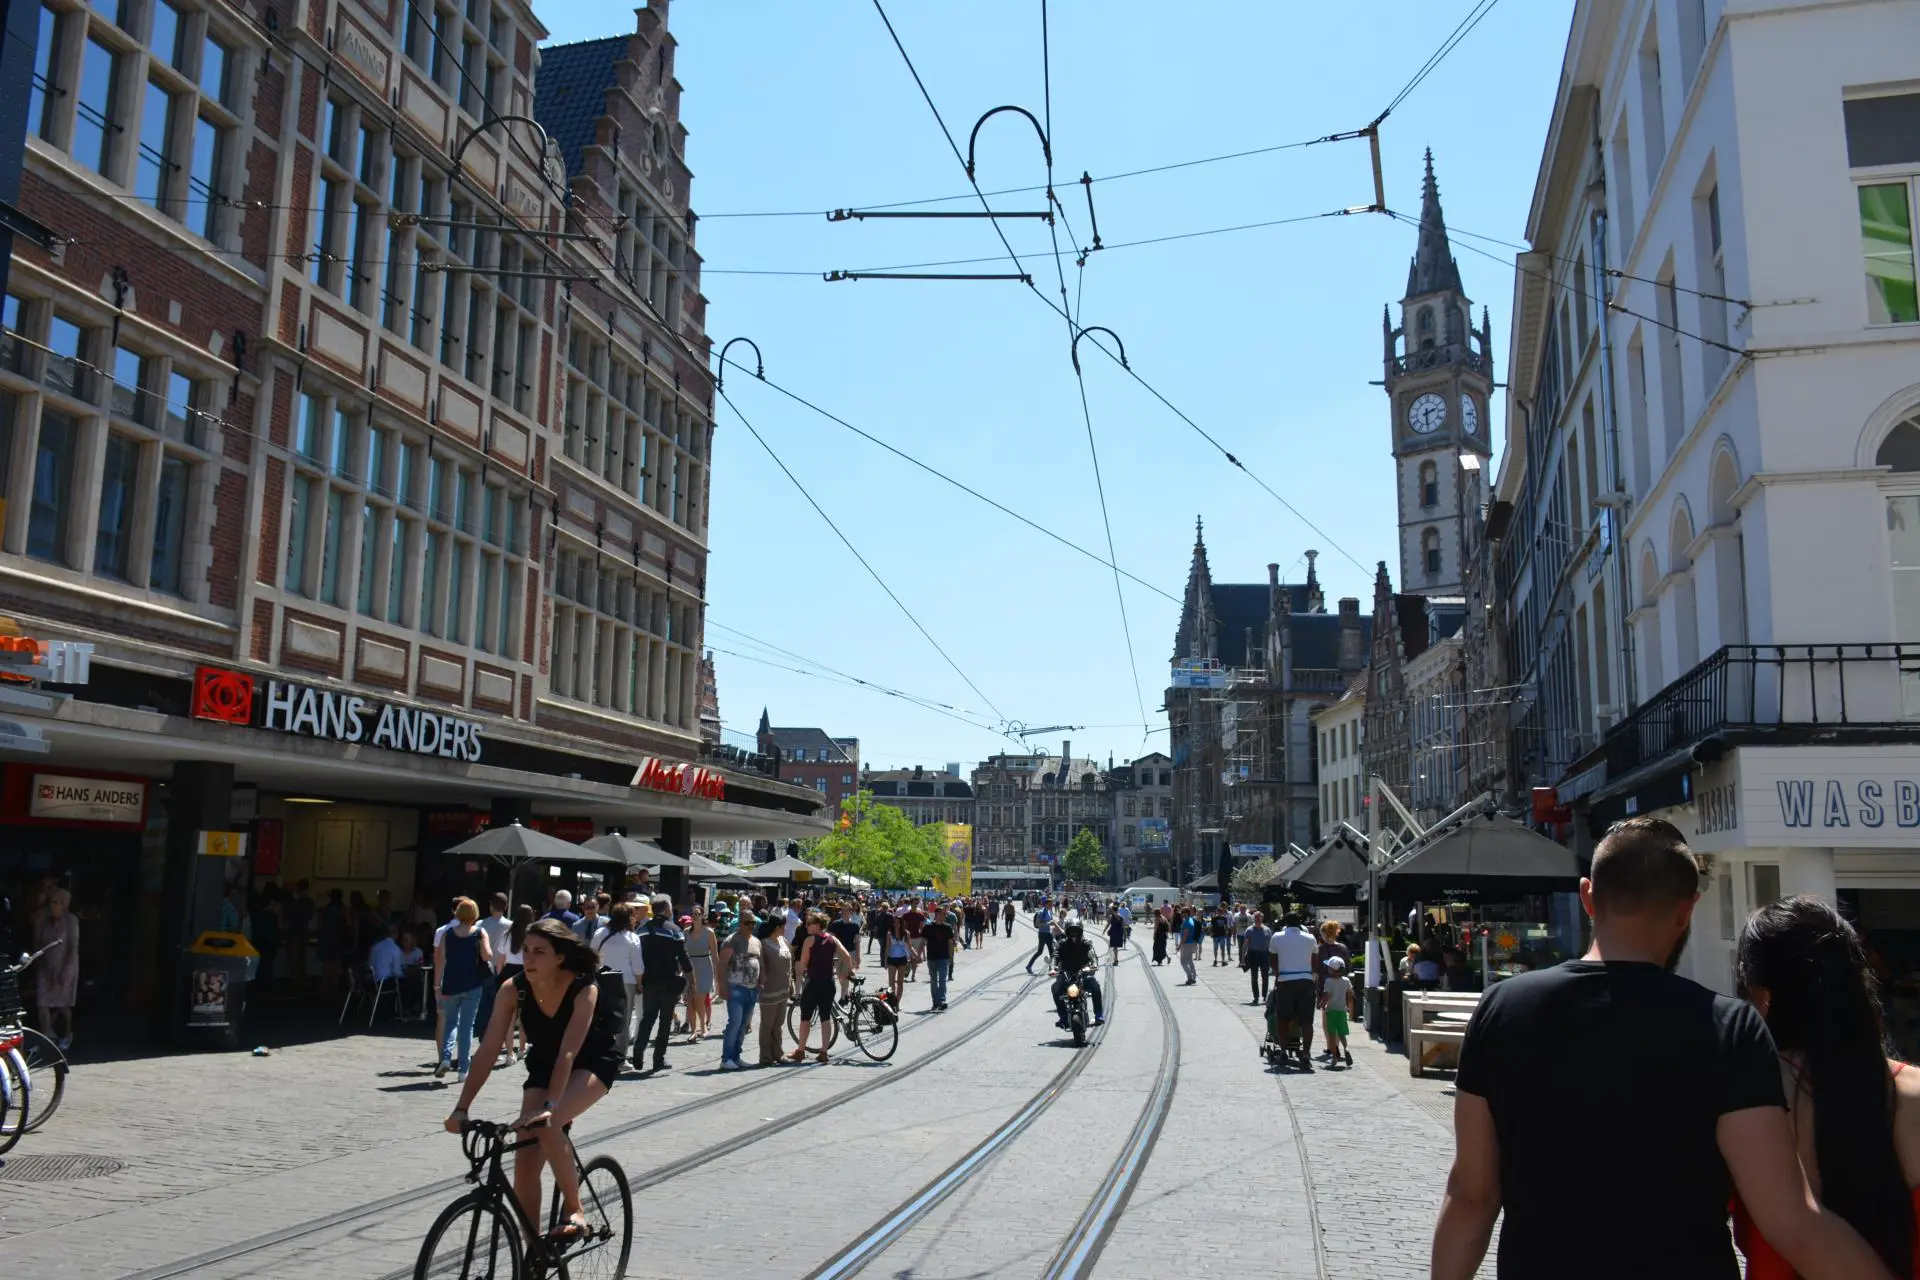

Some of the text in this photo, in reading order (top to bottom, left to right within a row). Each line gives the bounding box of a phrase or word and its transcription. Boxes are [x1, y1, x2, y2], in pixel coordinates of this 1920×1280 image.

[344, 31, 385, 77] ANNO
[48, 640, 95, 684] FIT
[265, 680, 484, 762] HANS ANDERS
[56, 786, 140, 805] HANS ANDERS
